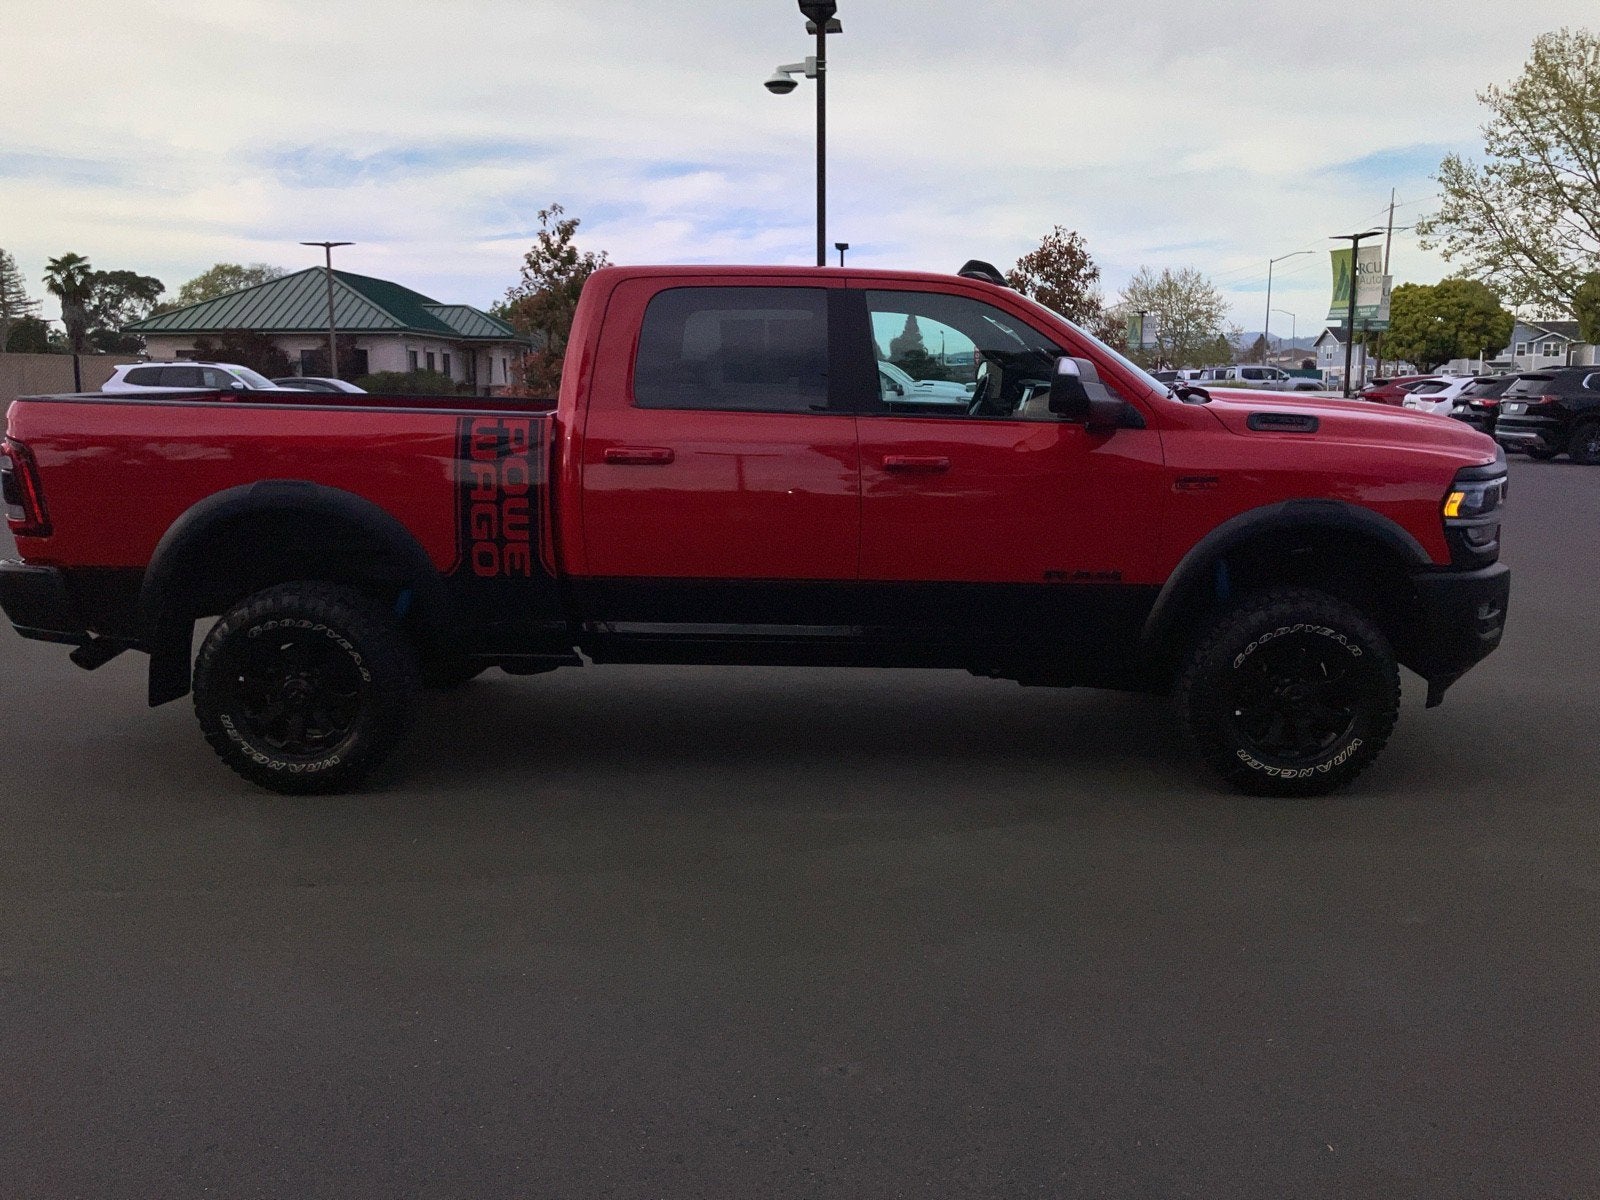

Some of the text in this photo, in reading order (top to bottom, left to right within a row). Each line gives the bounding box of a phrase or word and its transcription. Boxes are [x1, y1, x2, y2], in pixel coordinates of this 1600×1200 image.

[1359, 261, 1382, 274] RCU
[1359, 275, 1382, 284] Auto
[248, 618, 372, 682] GOODYEAR
[1233, 624, 1363, 669] GOODYEAR
[220, 714, 341, 773] WRANGLER
[1236, 738, 1363, 778] WRANGLER
